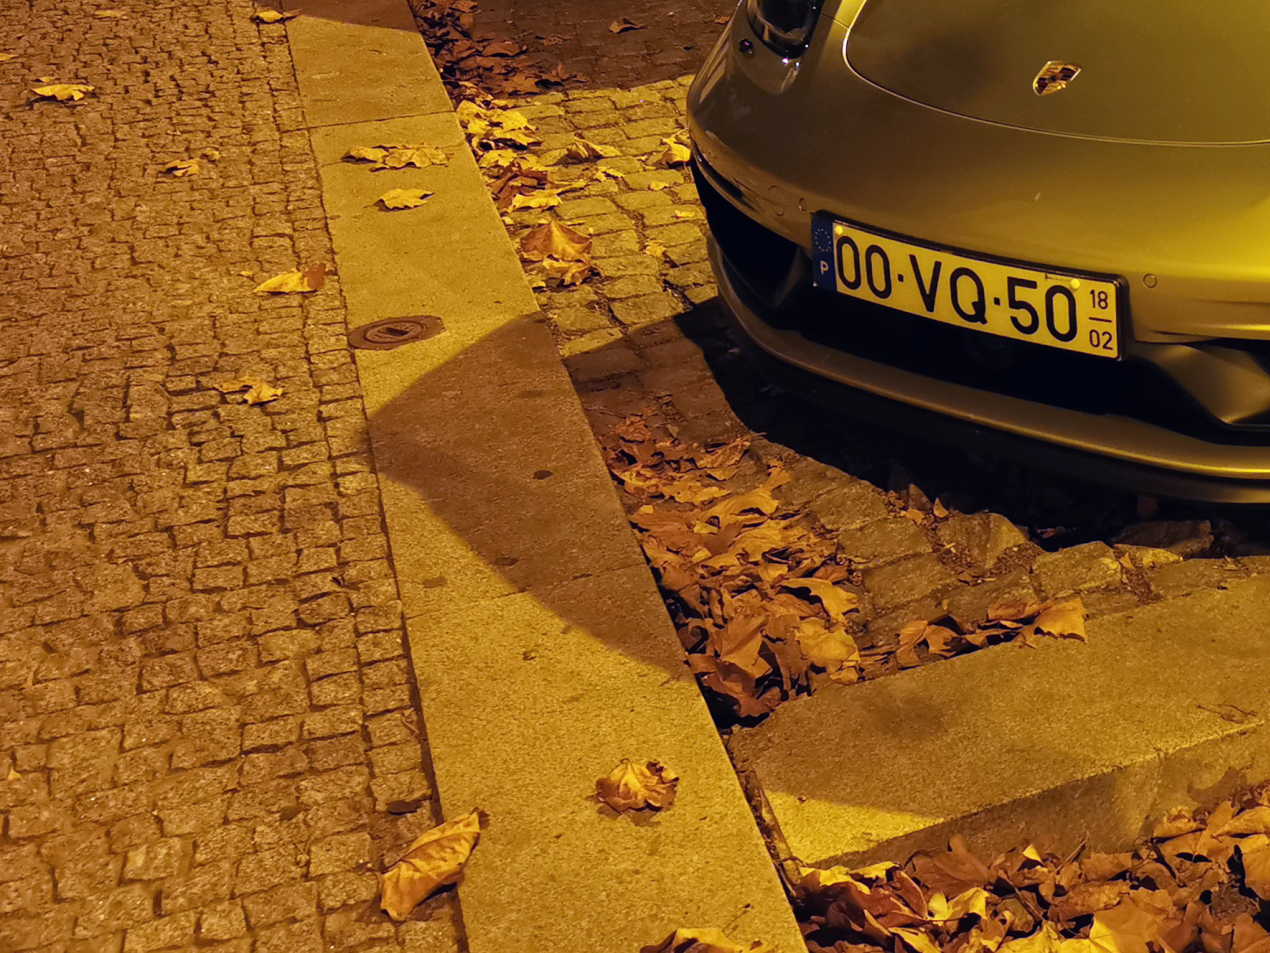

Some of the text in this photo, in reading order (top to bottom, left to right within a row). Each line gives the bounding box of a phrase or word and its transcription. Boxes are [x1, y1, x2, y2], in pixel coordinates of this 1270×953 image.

[819, 260, 829, 275] P
[1089, 289, 1109, 310] 18
[1089, 329, 1114, 350] 02
